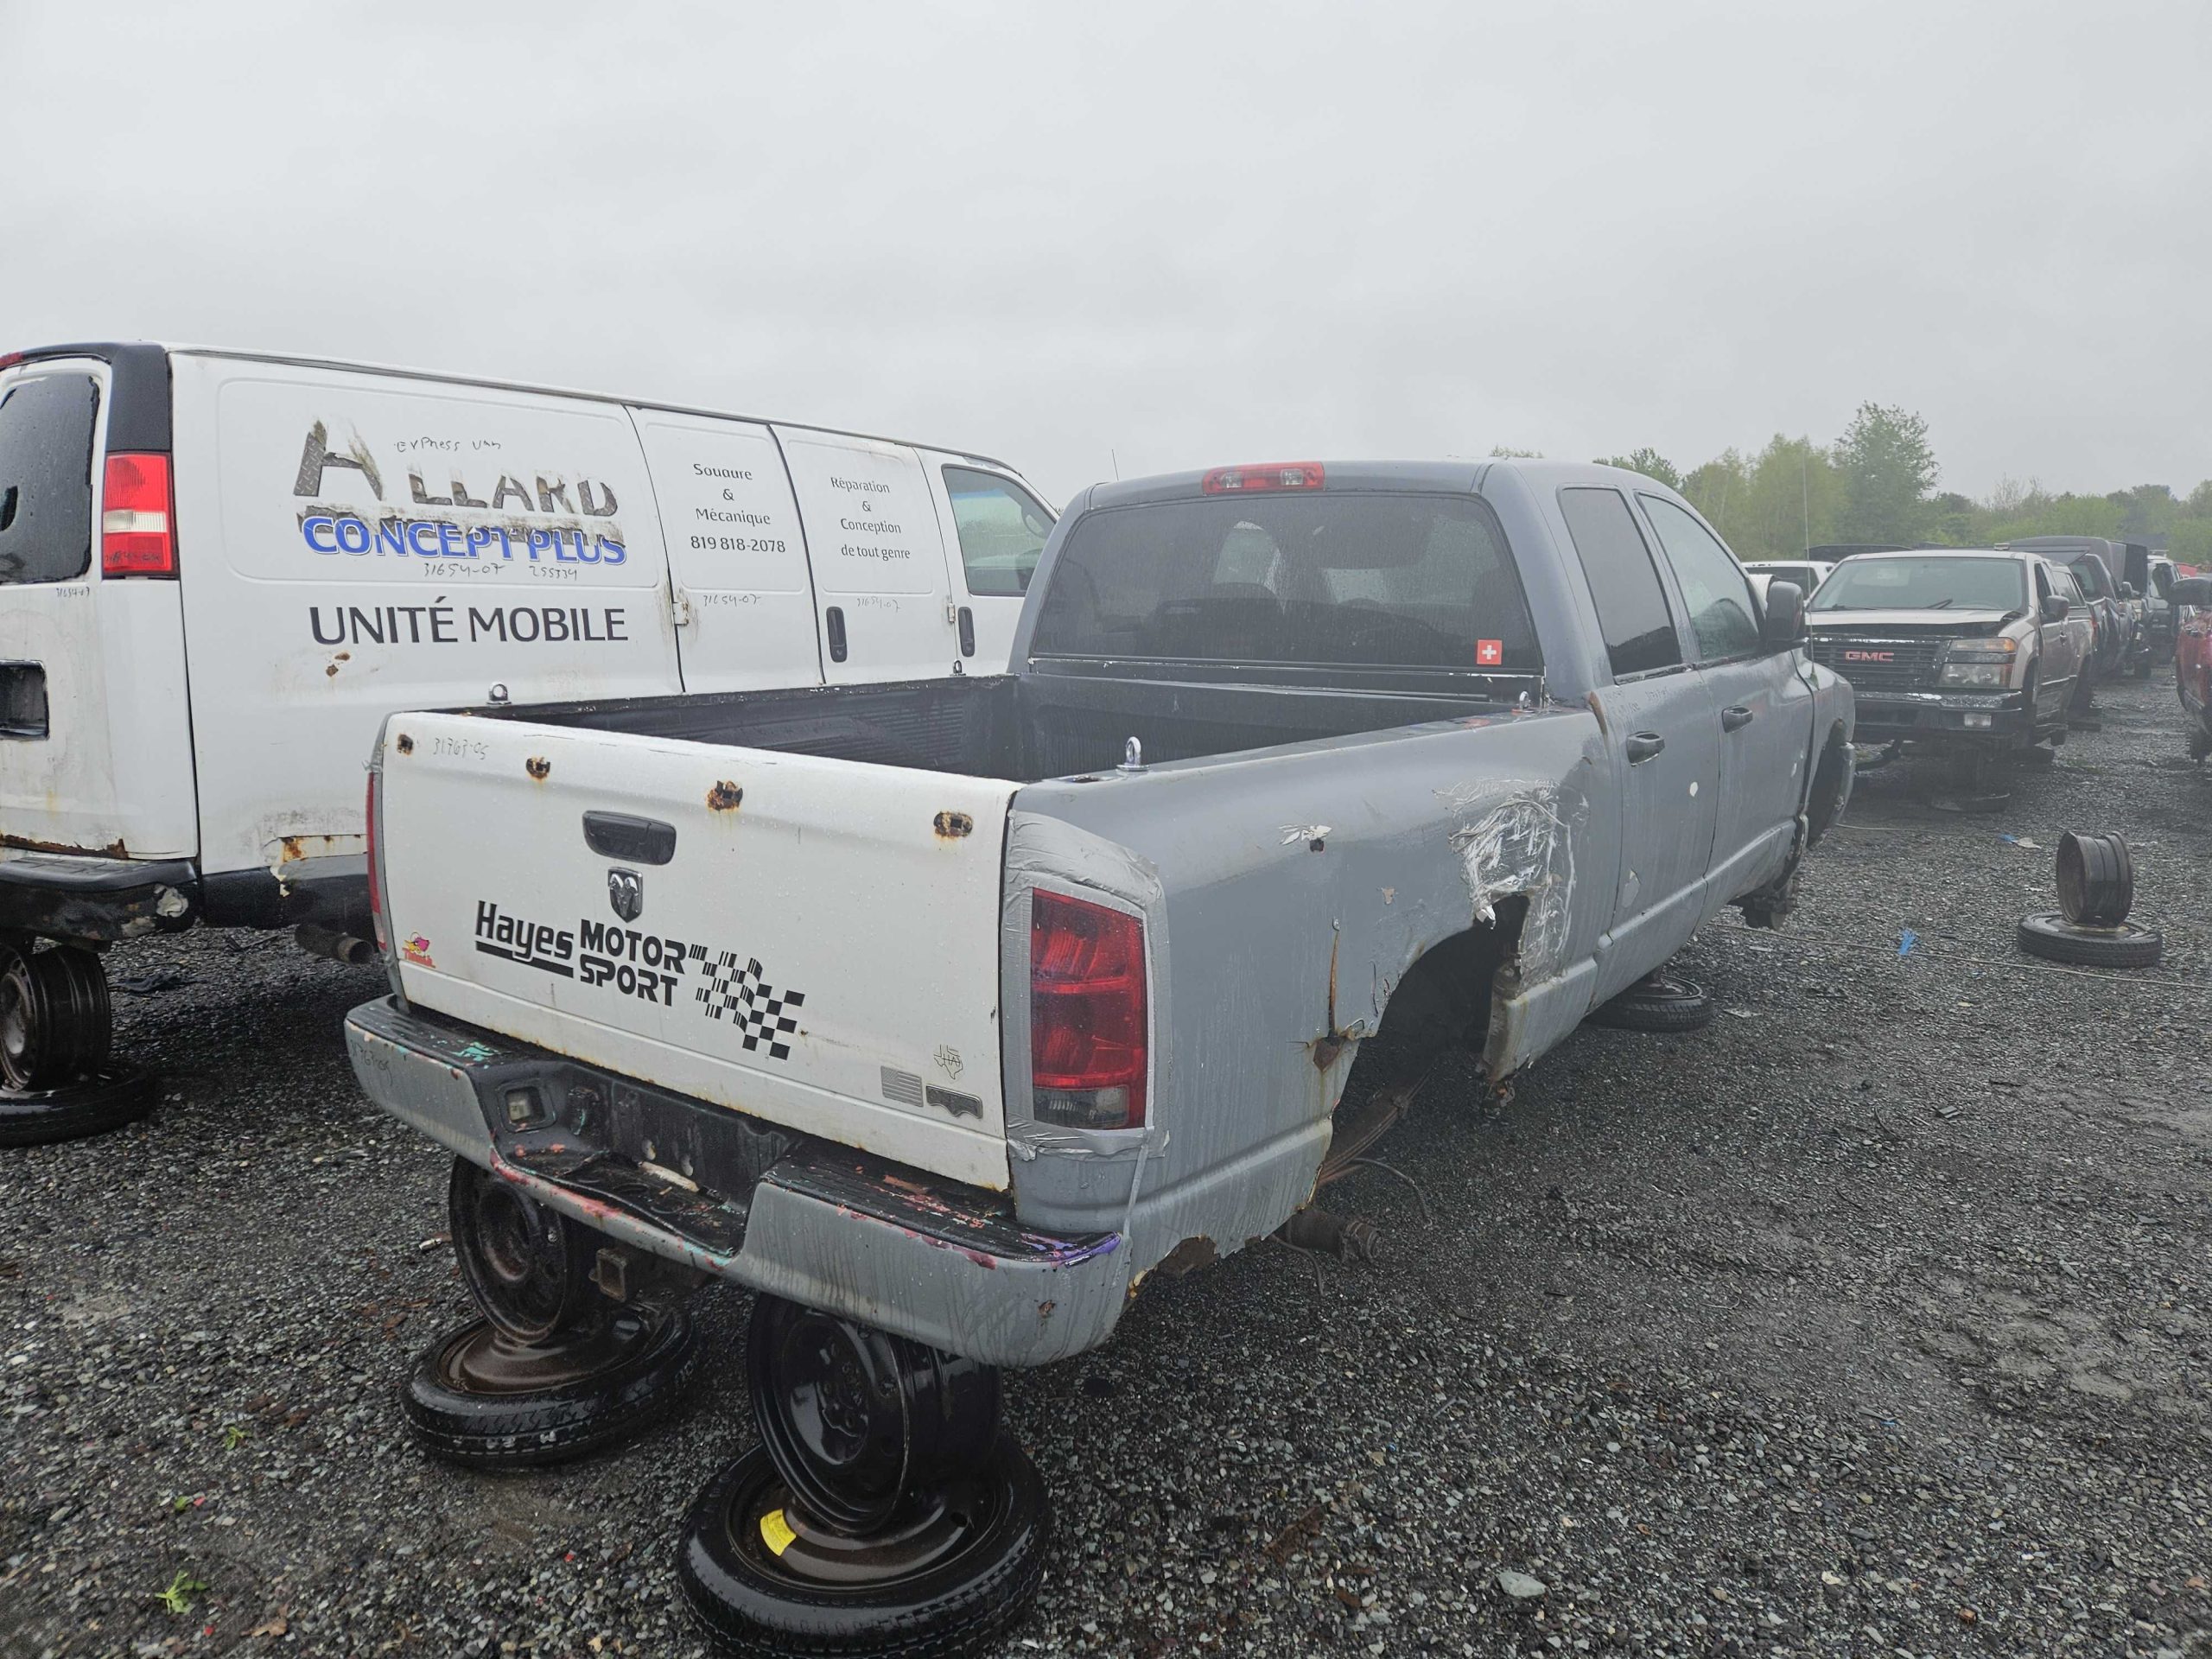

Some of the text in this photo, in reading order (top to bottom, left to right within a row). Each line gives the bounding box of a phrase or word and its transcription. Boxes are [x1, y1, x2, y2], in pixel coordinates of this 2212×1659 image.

[830, 477, 890, 493] Réparation
[722, 488, 734, 501] &
[861, 500, 871, 512] &
[696, 508, 771, 527] Mécanique
[840, 518, 901, 535] Conception
[302, 515, 627, 567] CONCEPT PLUS
[690, 536, 785, 553] 819 818-2078
[841, 543, 911, 562] de tout genre
[308, 596, 629, 645] UNITÉ MOBILE
[1845, 651, 1895, 662] GMC
[476, 899, 687, 975] Hayes MOTOR
[579, 953, 678, 1007] SPORT
